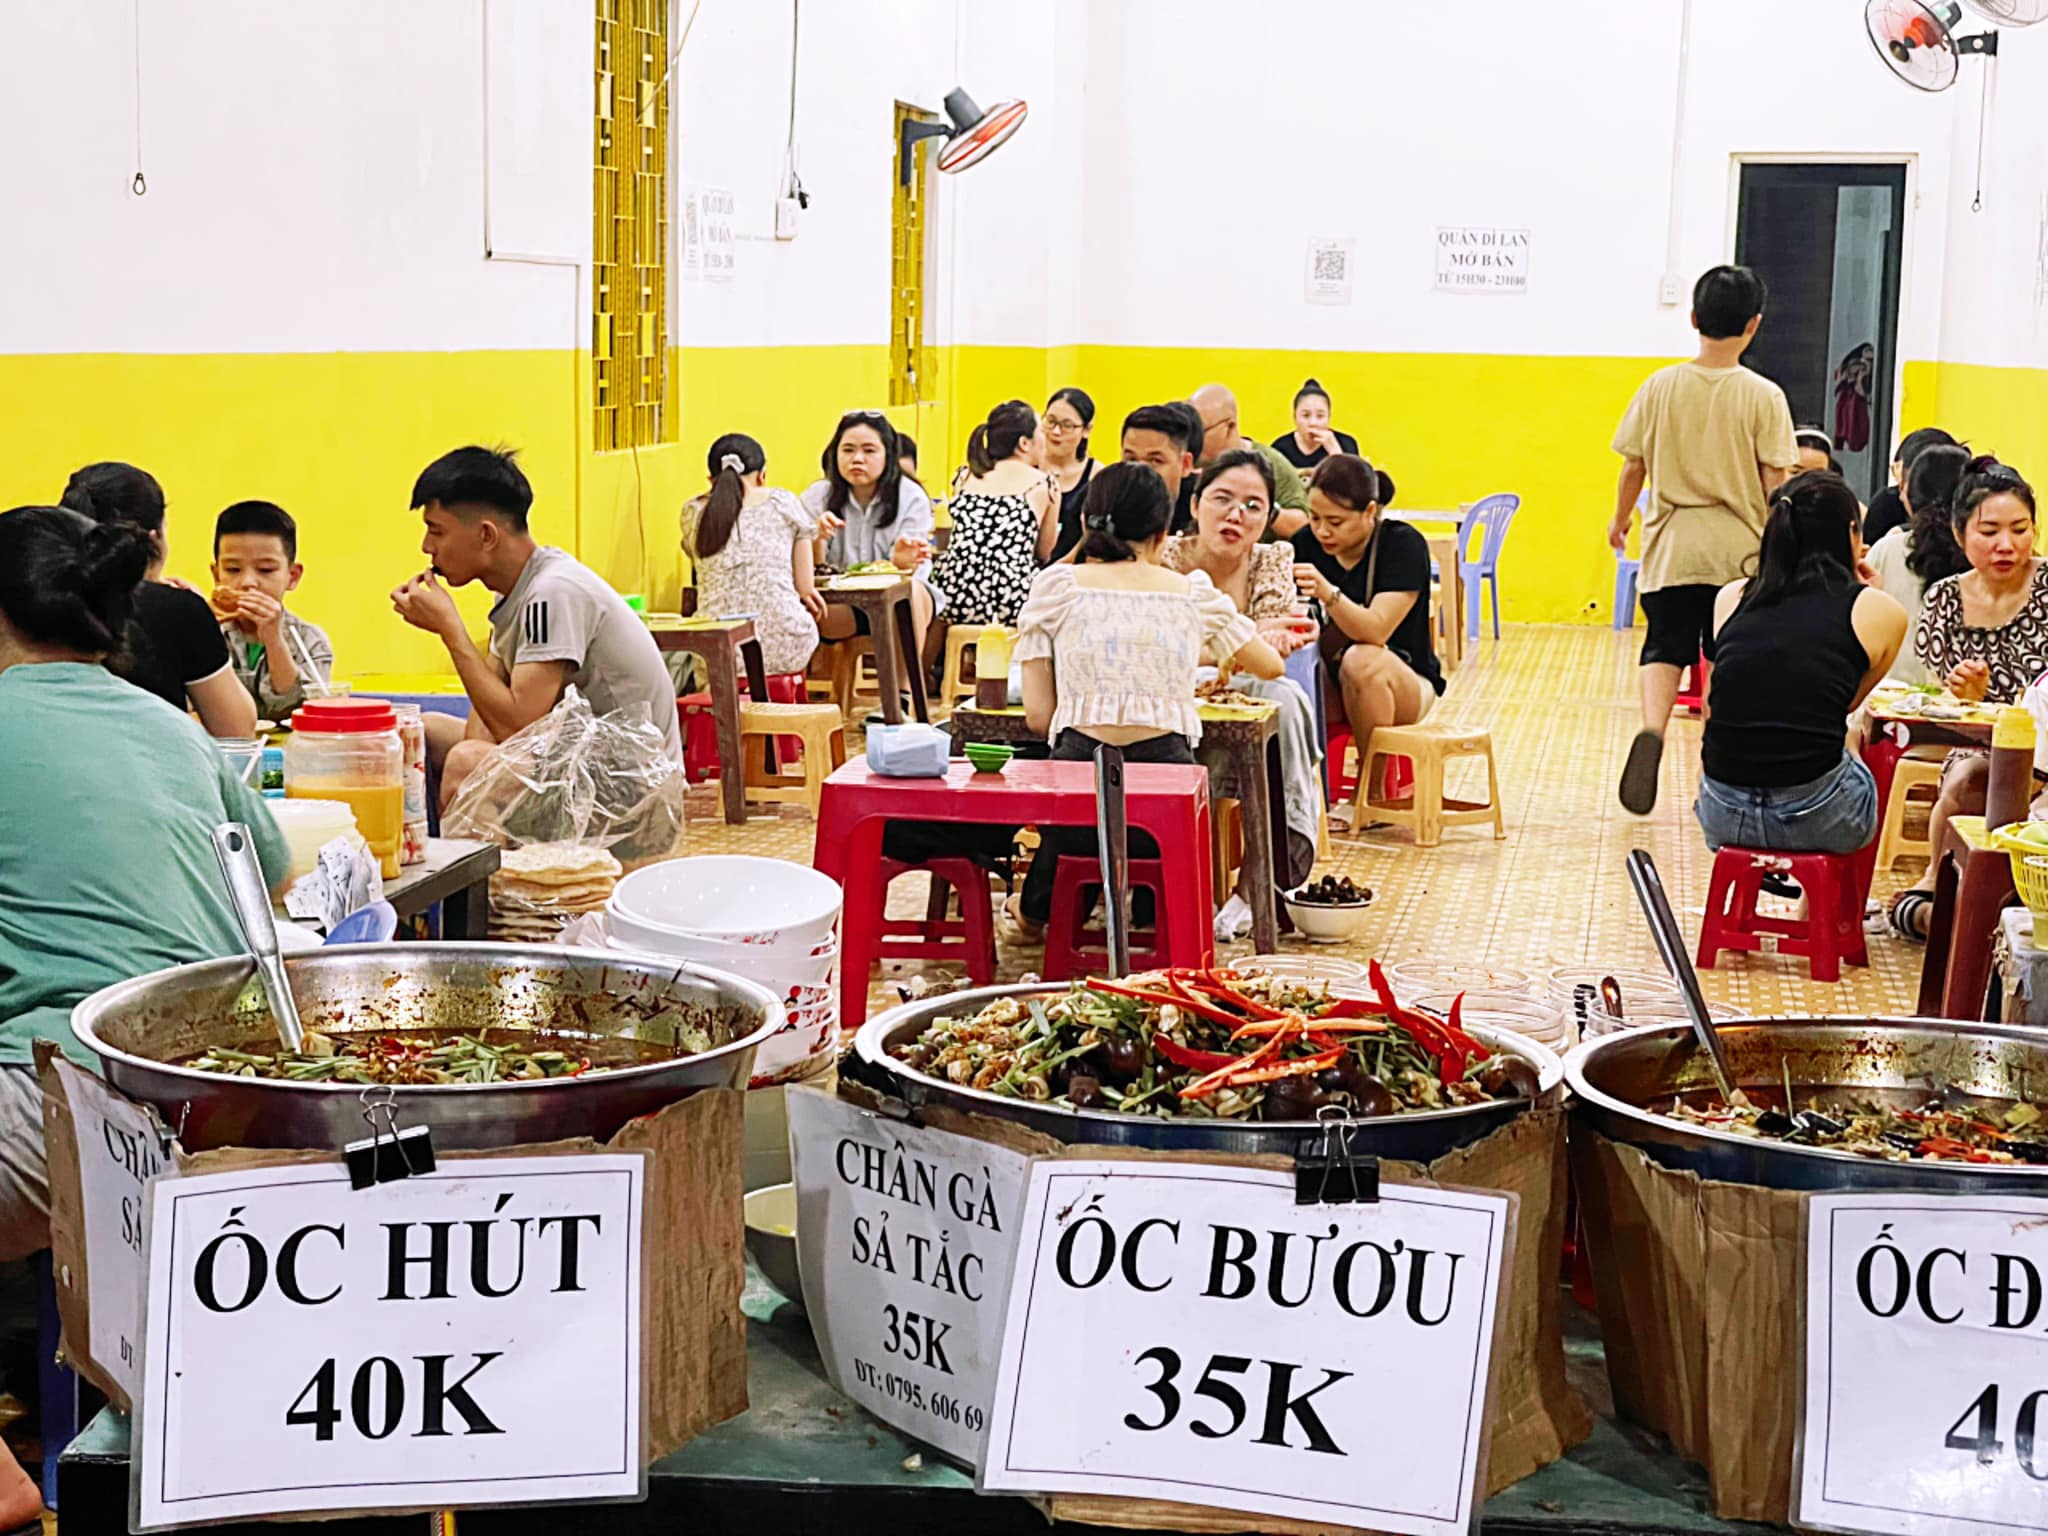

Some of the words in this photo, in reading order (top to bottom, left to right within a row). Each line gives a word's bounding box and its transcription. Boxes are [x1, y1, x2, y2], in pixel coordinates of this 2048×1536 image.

[1438, 227, 1478, 247] QUÁN
[1500, 232, 1528, 247] LAN
[1481, 250, 1515, 267] BÁN
[836, 1138, 938, 1211] CHÂN
[948, 1166, 1002, 1232] GÀ
[194, 1206, 345, 1312] ỐC
[378, 1193, 601, 1300] HÚT
[853, 1210, 897, 1274] SẢ
[906, 1230, 983, 1302] TẮC
[1056, 1194, 1181, 1292] ỐC
[1200, 1223, 1466, 1327] BƯƠU
[1856, 1223, 1966, 1324] ỐC
[1989, 1253, 2048, 1333] Đ
[883, 1303, 954, 1375] 35K
[286, 1351, 506, 1441] 40K
[931, 1391, 960, 1424] 606
[1124, 1347, 1354, 1456] 35K
